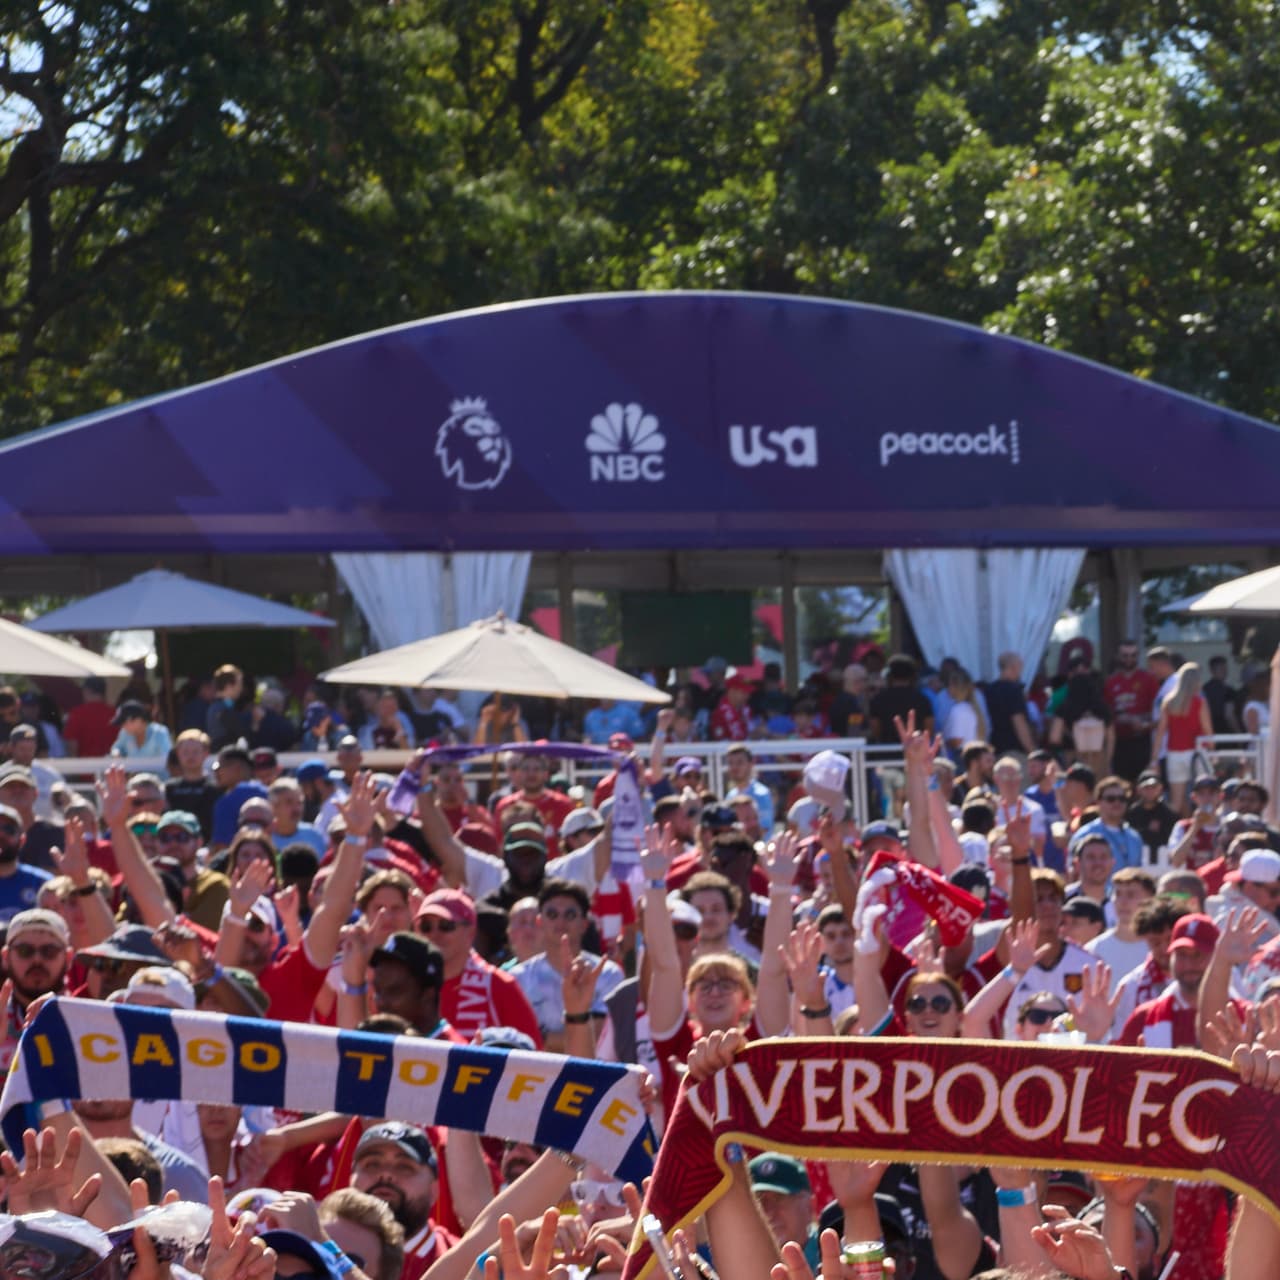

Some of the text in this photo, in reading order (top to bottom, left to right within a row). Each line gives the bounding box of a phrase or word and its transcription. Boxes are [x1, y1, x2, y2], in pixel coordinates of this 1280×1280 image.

[880, 424, 1008, 467] peacock
[590, 454, 665, 482] NBC
[10, 1033, 652, 1152] ICAGO TOFFEE
